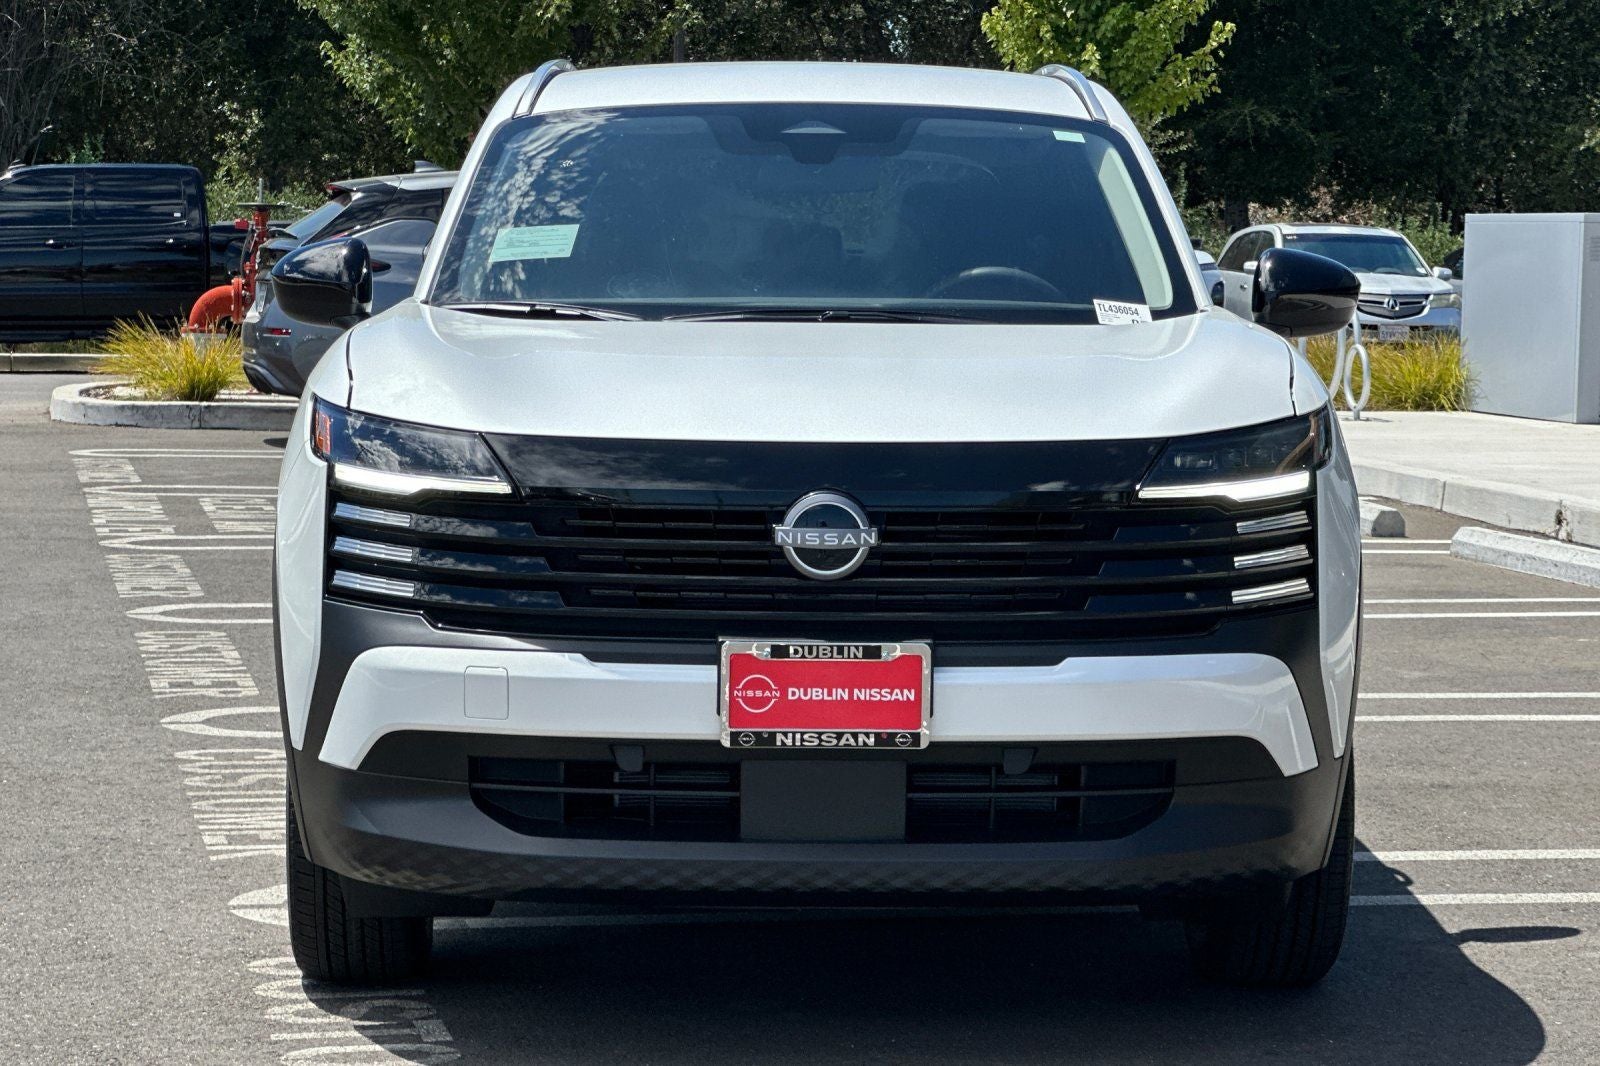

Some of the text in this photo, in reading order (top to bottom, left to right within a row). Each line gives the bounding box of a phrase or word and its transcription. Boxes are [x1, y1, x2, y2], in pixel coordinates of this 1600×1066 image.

[1096, 303, 1140, 317] TL436054
[777, 531, 876, 545] NISSAN
[104, 554, 204, 598] CUSTOMER
[789, 645, 863, 659] DUBLIN
[133, 630, 259, 698] CUSTOMER
[734, 689, 780, 698] NISSAN
[787, 687, 915, 702] DUBLIN NISSAN
[775, 732, 875, 747] NISSAN
